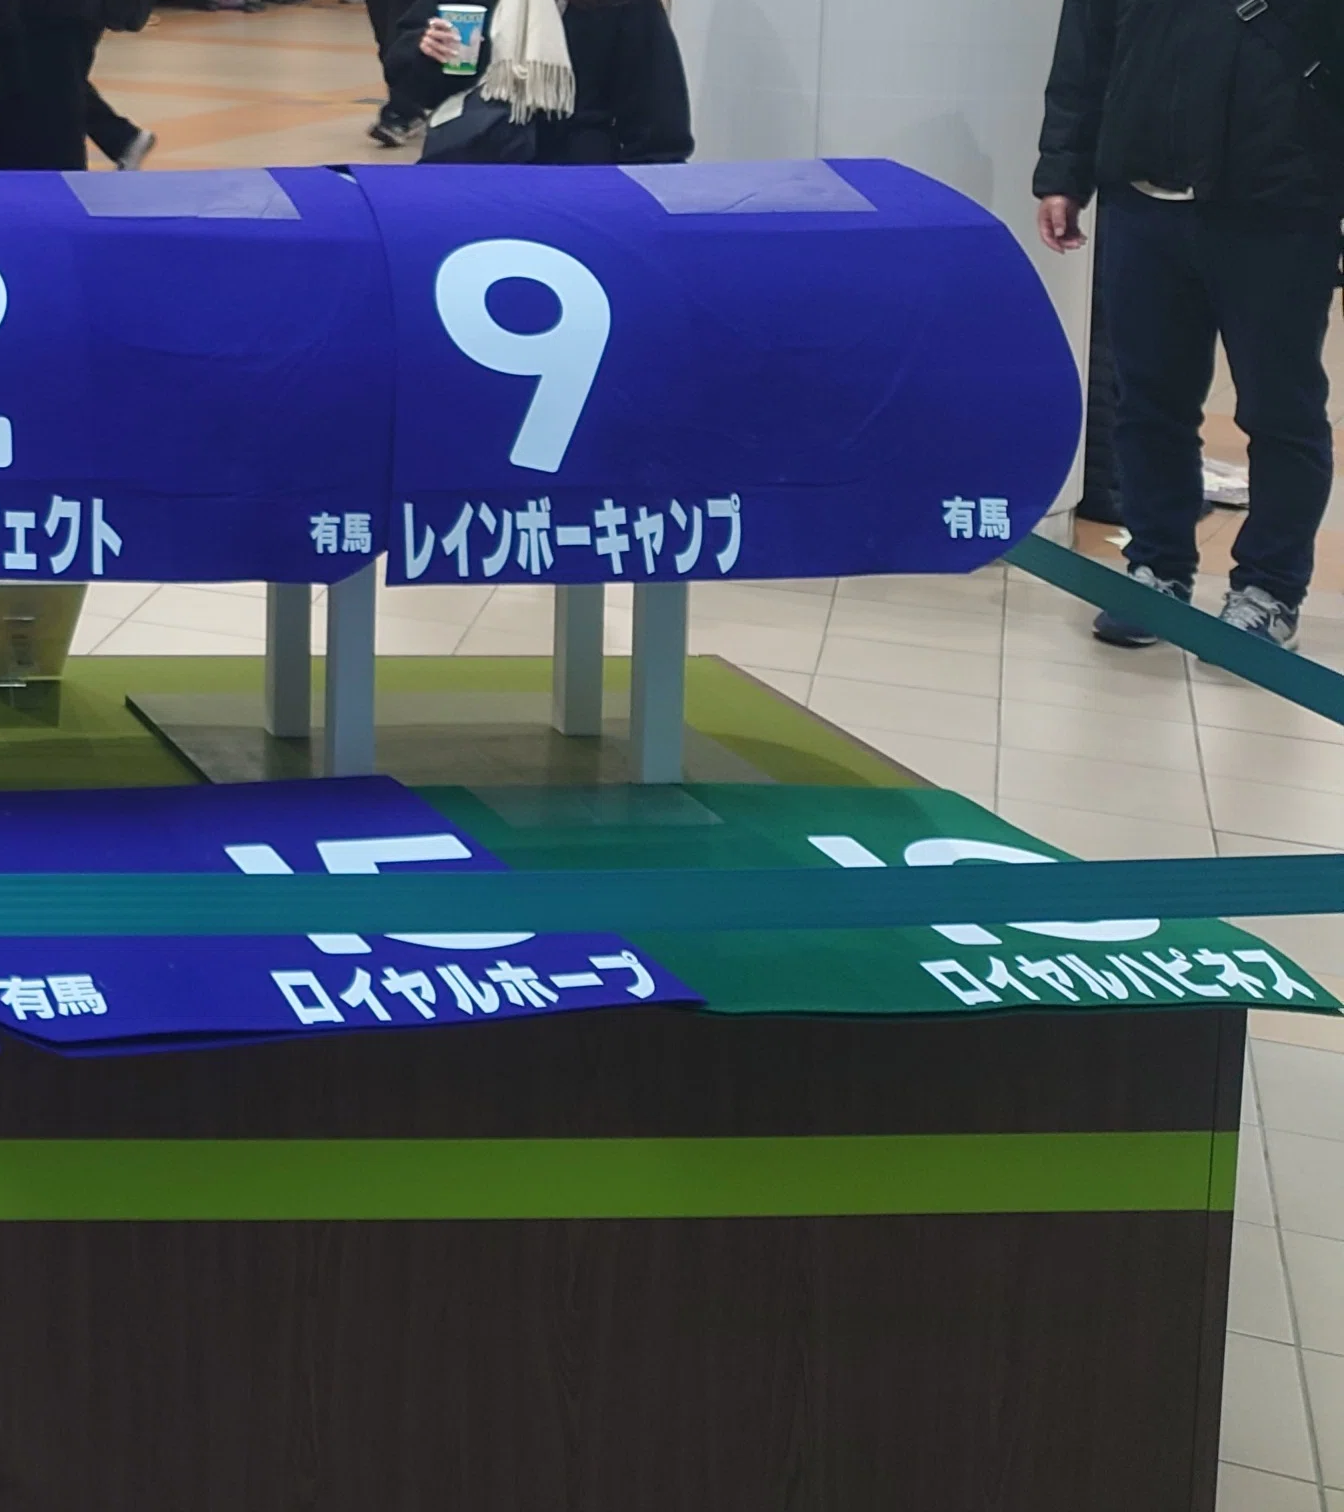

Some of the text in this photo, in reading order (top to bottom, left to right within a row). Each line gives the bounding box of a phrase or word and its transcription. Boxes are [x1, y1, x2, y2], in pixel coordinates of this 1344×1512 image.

[435, 238, 612, 473] 9
[310, 512, 373, 555] 有馬
[402, 492, 742, 579] レインボーキャンプ
[942, 495, 1011, 540] 有馬
[270, 949, 657, 1025] ロイヤルホープ
[919, 946, 1316, 1006] ロイヤルハピネス
